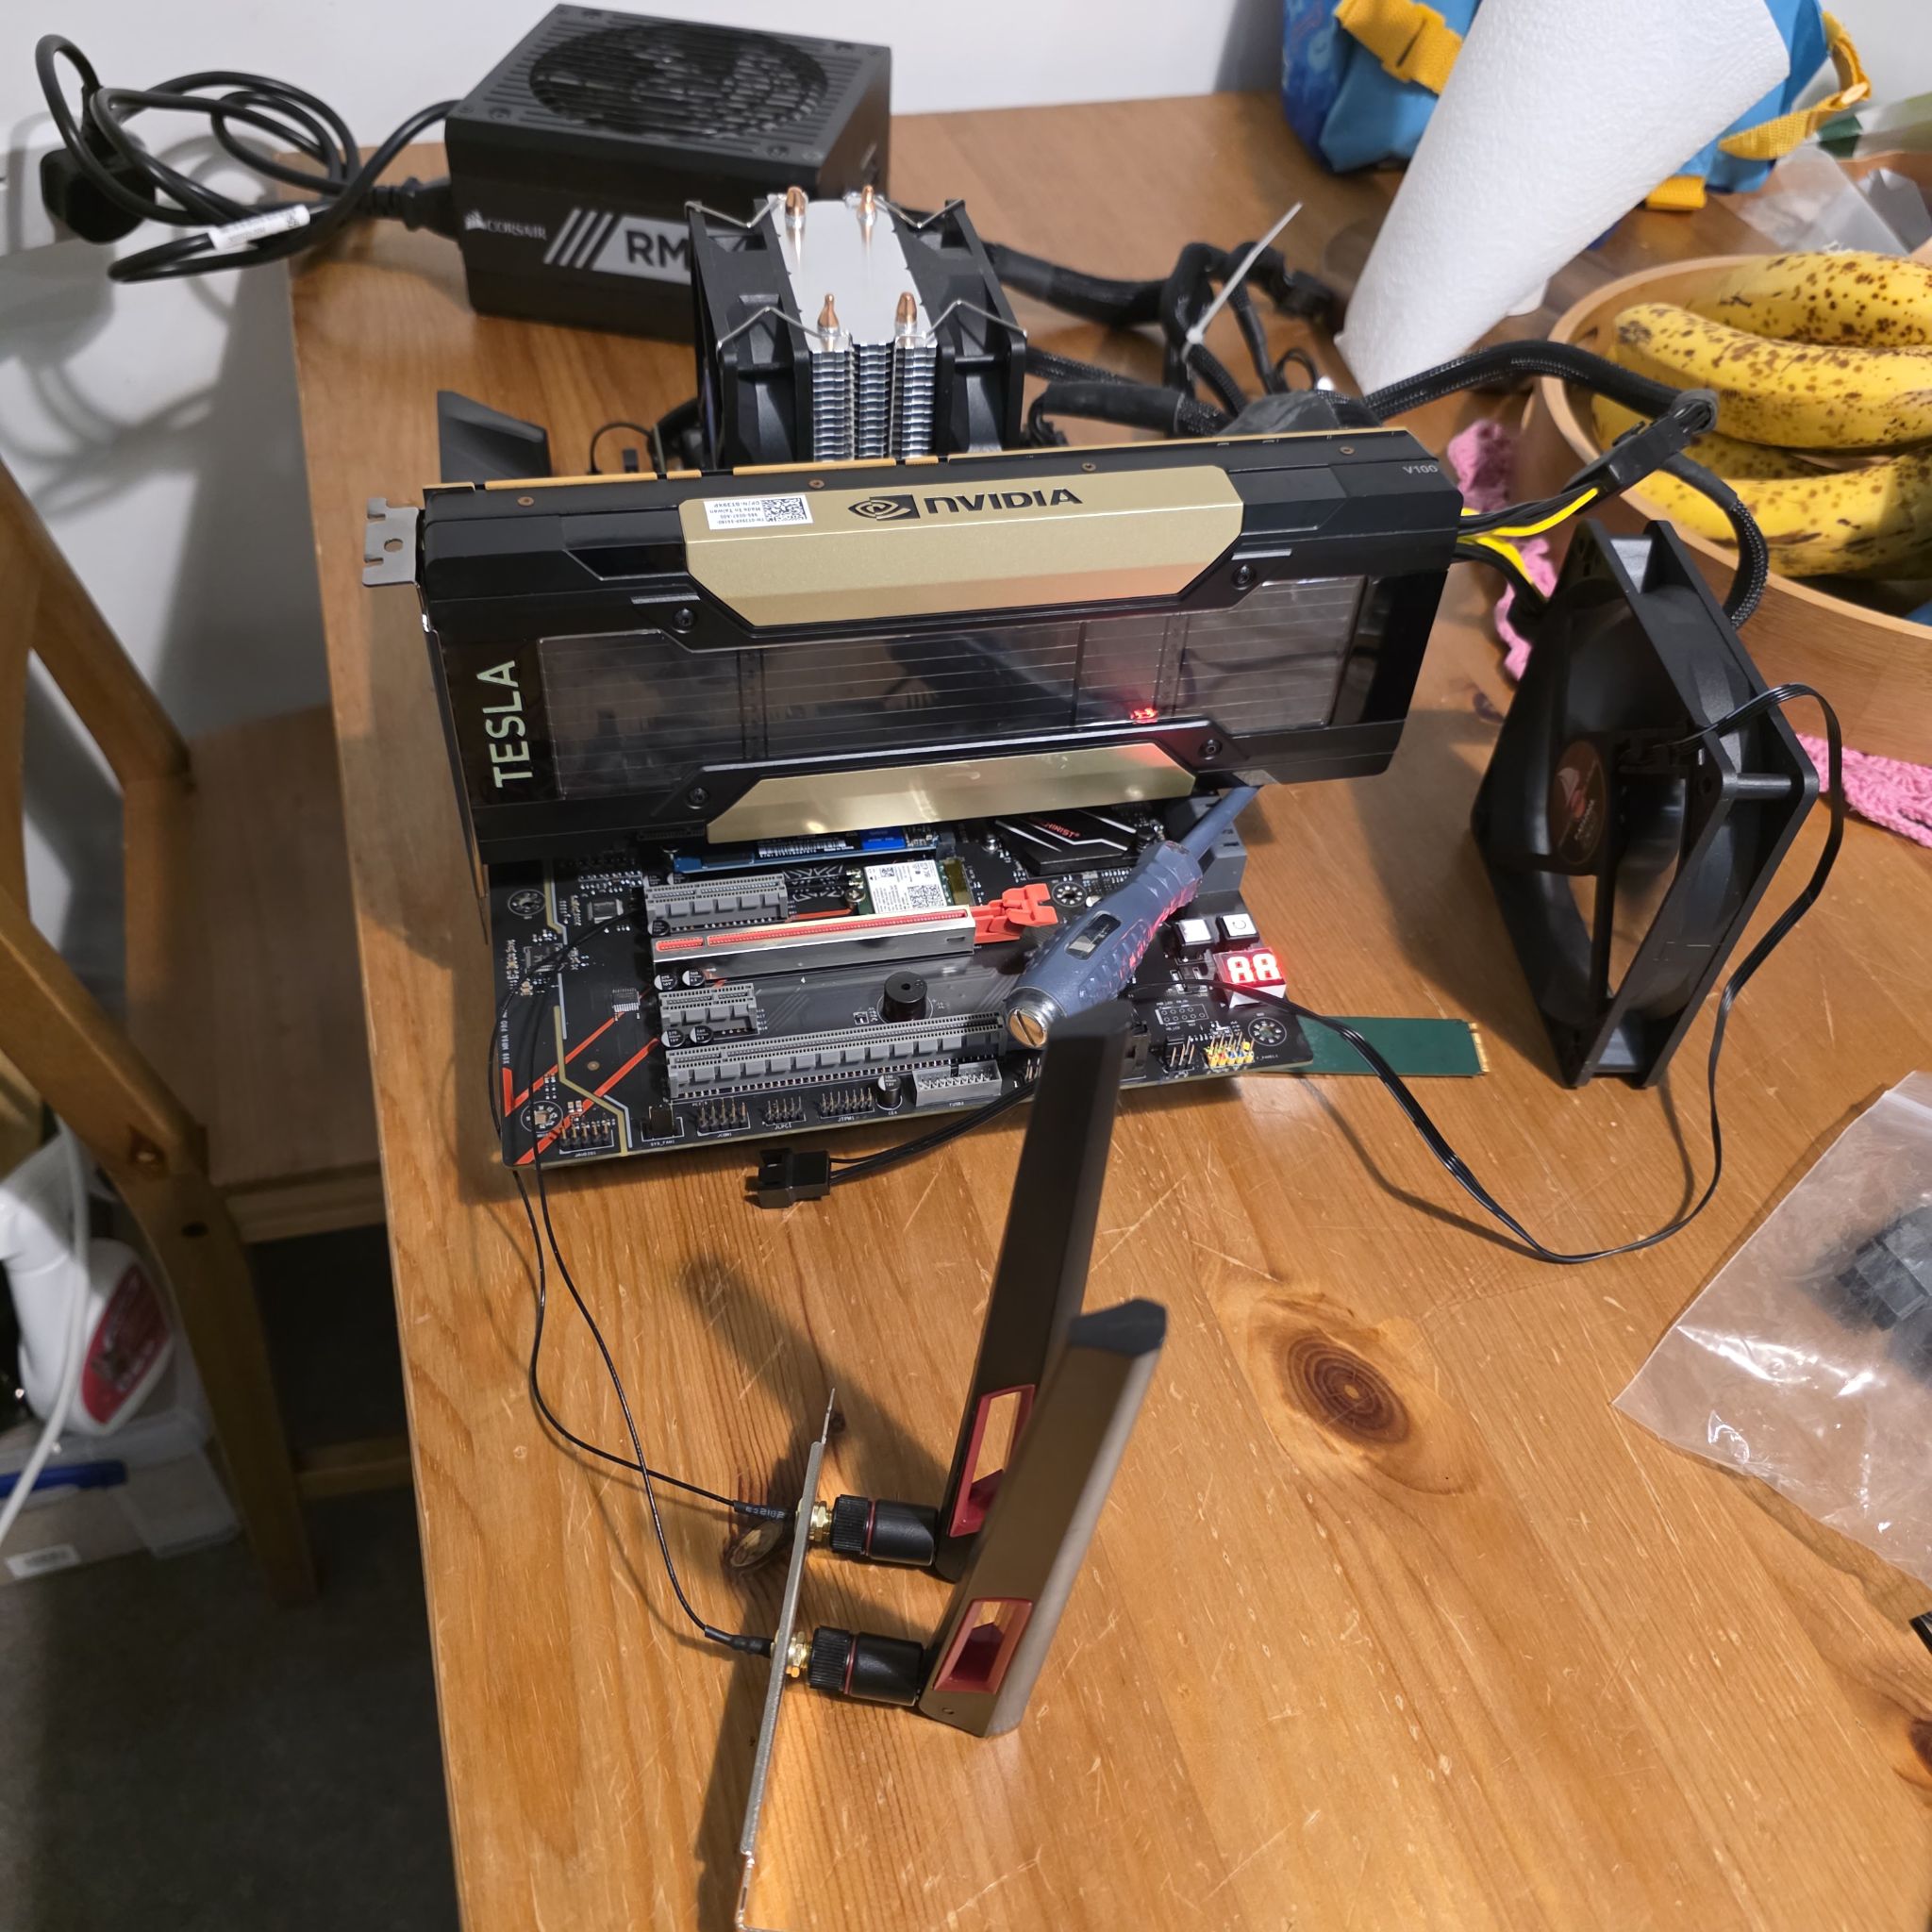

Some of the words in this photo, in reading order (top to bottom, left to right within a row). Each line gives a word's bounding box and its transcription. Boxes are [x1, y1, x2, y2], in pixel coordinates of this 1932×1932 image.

[487, 219, 547, 241] CORSAIR
[1402, 464, 1439, 475] V100
[924, 488, 1083, 514] NVIDIA
[475, 660, 533, 788] TESLA
